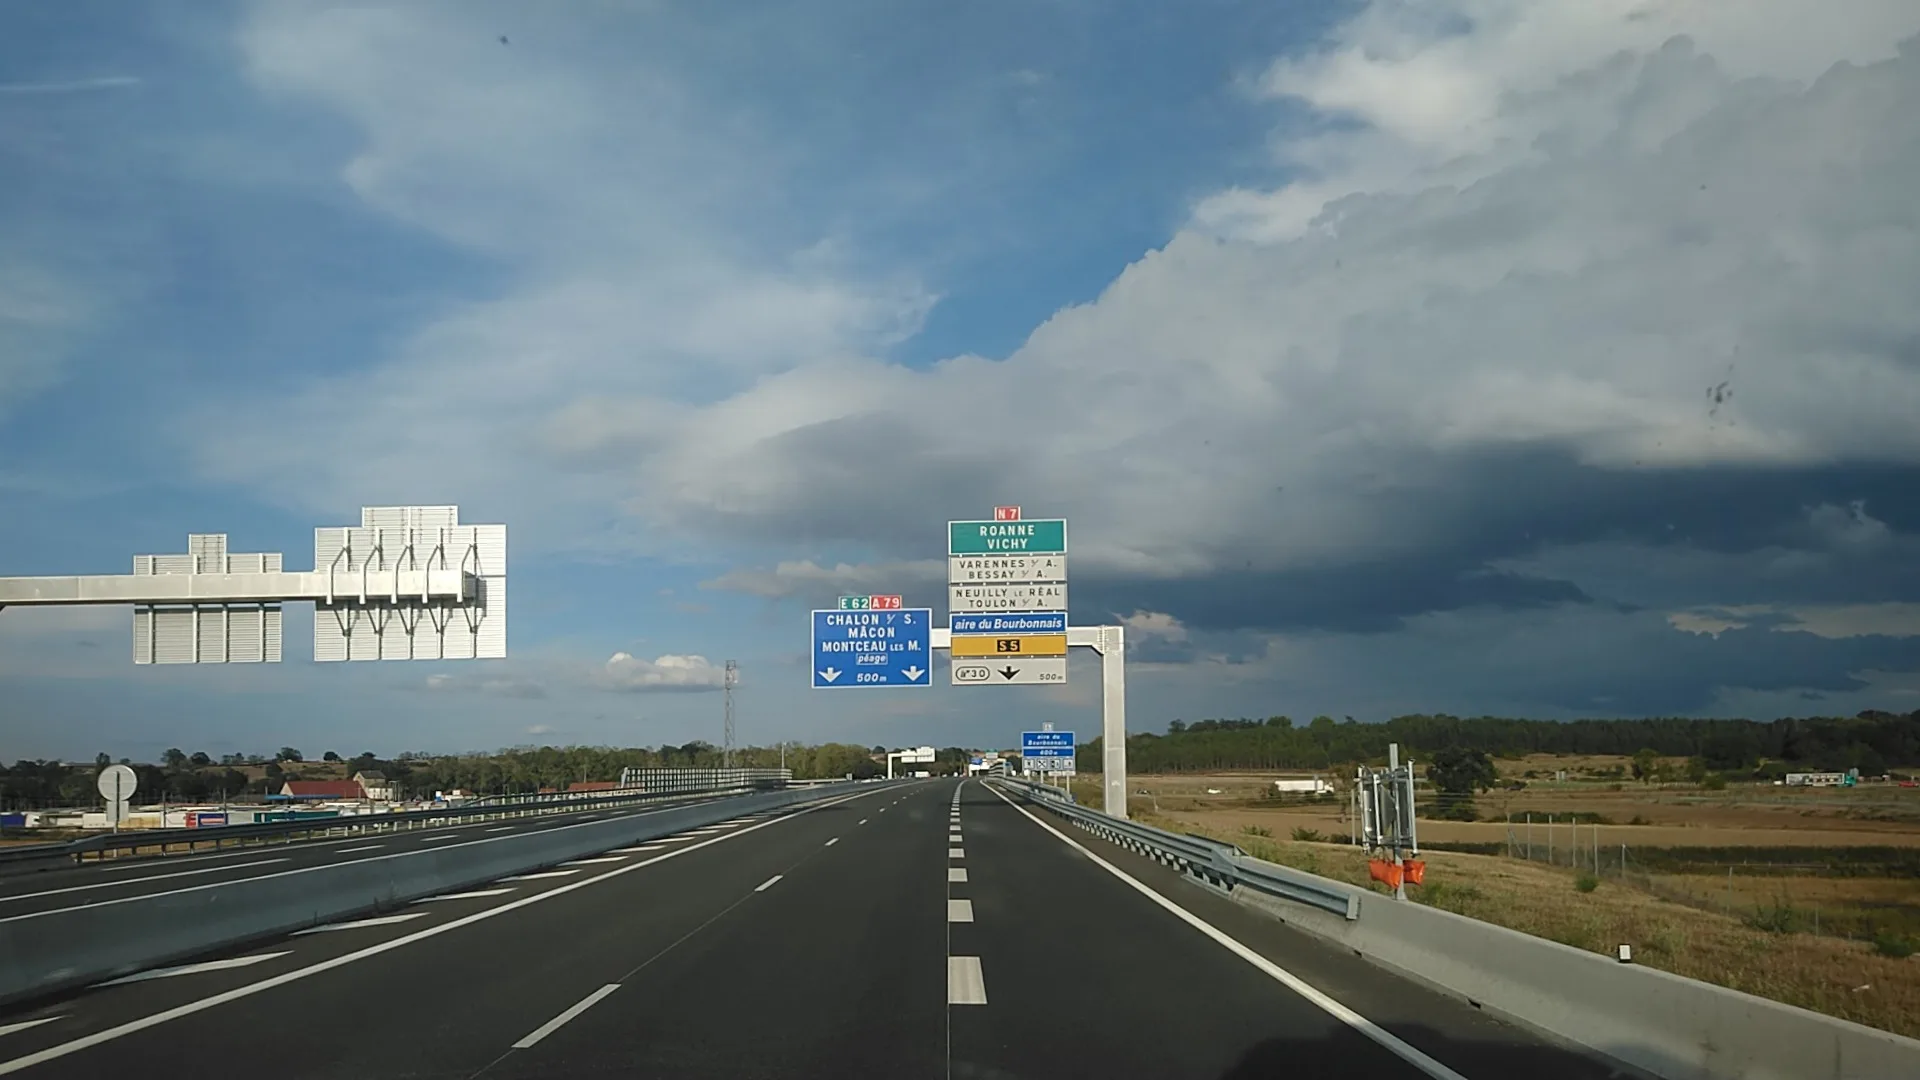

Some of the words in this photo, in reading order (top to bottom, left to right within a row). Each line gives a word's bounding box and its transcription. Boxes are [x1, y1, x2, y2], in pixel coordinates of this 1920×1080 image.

[998, 509, 1005, 519] N
[1010, 509, 1017, 519] 7
[980, 525, 1035, 536] ROANNE
[987, 539, 1028, 549] VICHY
[959, 560, 1025, 568] VARENNES
[1046, 559, 1057, 568] A.
[969, 570, 1015, 579] BESSAY
[1036, 570, 1047, 578] A.
[956, 589, 1007, 597] NEUILLY
[1029, 587, 1060, 596] RÉAL
[841, 599, 847, 608] E
[852, 598, 868, 608] 62
[872, 598, 880, 608] A
[884, 598, 899, 608] 79
[1037, 599, 1048, 607] A.
[827, 614, 879, 625] CHALON
[904, 614, 916, 624] S.
[955, 618, 976, 629] aire
[978, 619, 992, 629] du
[993, 617, 1062, 629] Bourbonnais
[848, 625, 895, 638] MÂCON
[822, 640, 886, 652] MONTCEAU
[890, 643, 904, 651] LES
[908, 640, 921, 651] M.
[999, 641, 1007, 651] S
[1010, 641, 1018, 650] 5
[858, 654, 886, 664] péage
